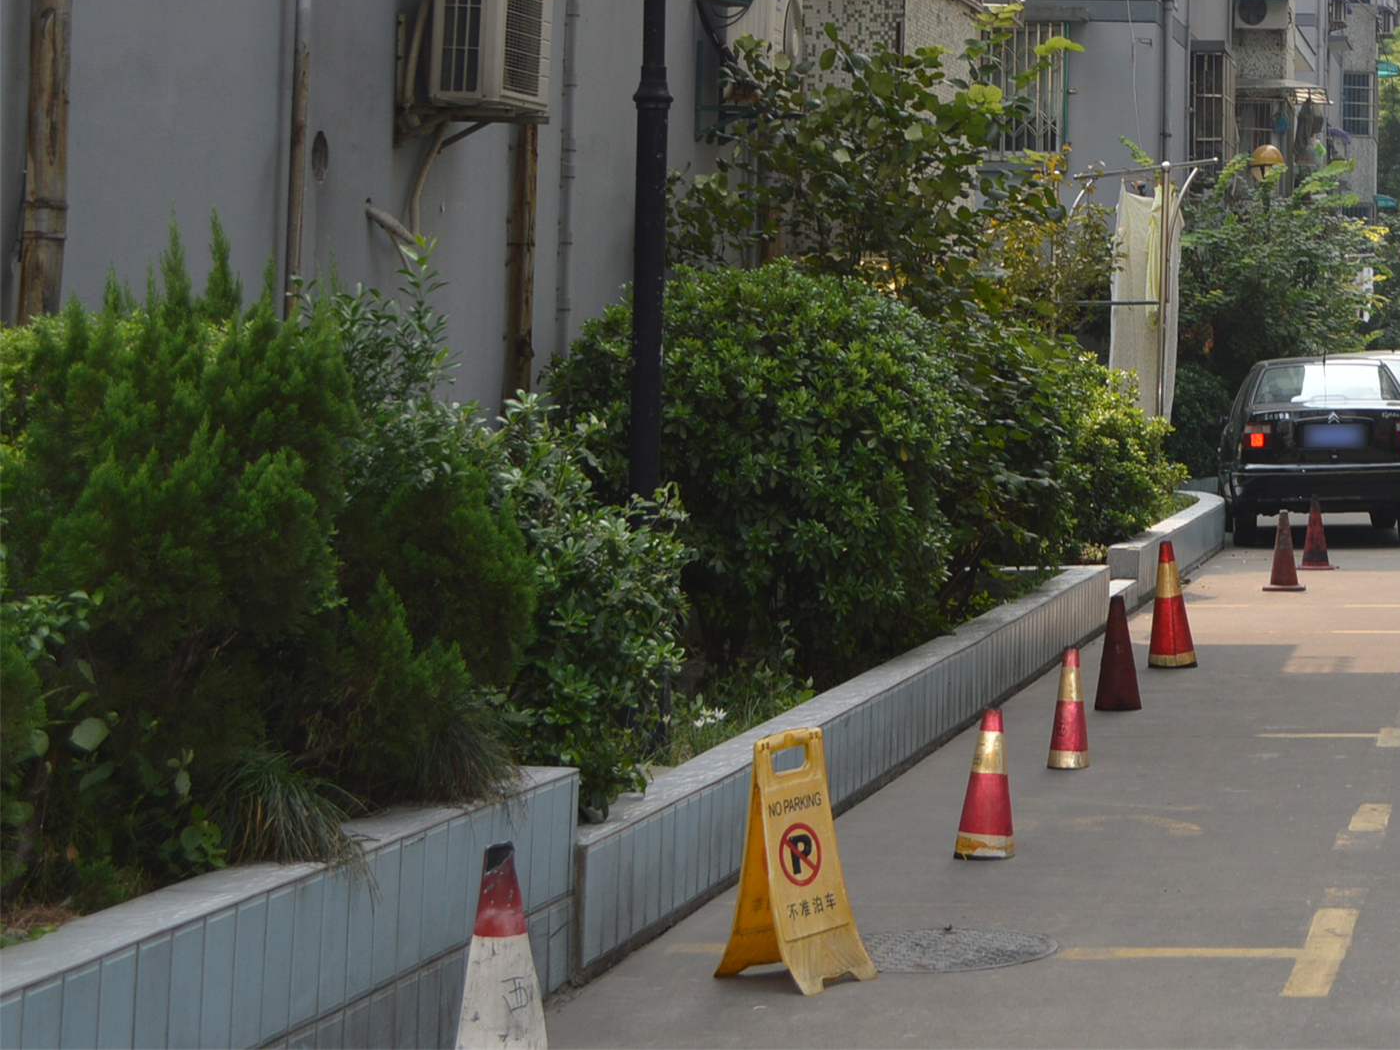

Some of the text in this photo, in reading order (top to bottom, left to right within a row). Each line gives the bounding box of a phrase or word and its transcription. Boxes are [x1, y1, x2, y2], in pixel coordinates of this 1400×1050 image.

[768, 791, 822, 818] NO PARKING
[786, 892, 837, 921] 不准泊车
